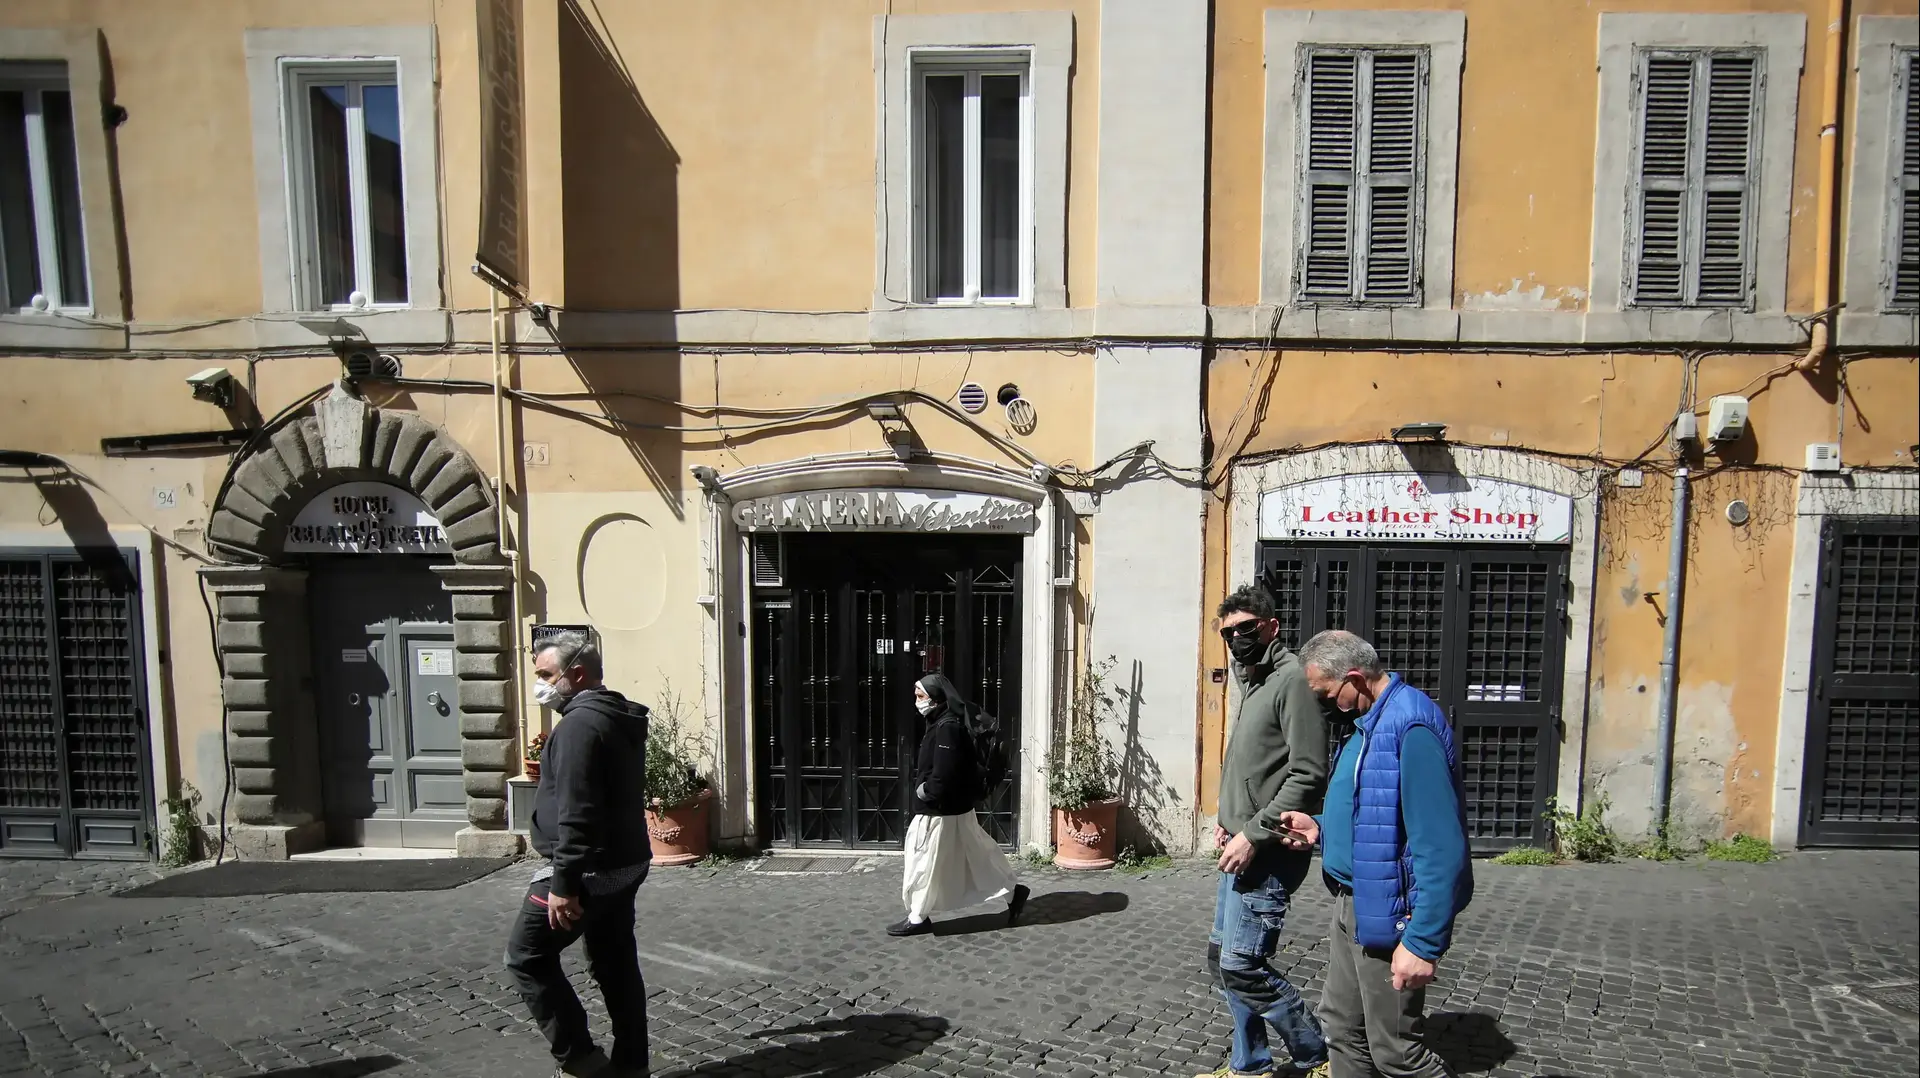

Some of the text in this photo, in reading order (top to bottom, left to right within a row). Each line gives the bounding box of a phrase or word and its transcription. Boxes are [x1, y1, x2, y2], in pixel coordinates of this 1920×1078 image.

[497, 119, 519, 265] RELAIS
[524, 445, 545, 463] 95
[158, 491, 175, 505] 94
[332, 496, 391, 514] HOTEL
[732, 492, 901, 527] GELATERIA
[909, 497, 1032, 531] Valentino
[1301, 506, 1538, 529] Leather Shop
[287, 525, 358, 544] RELAIS
[1291, 529, 1337, 538] Best
[1346, 529, 1426, 538] Roman
